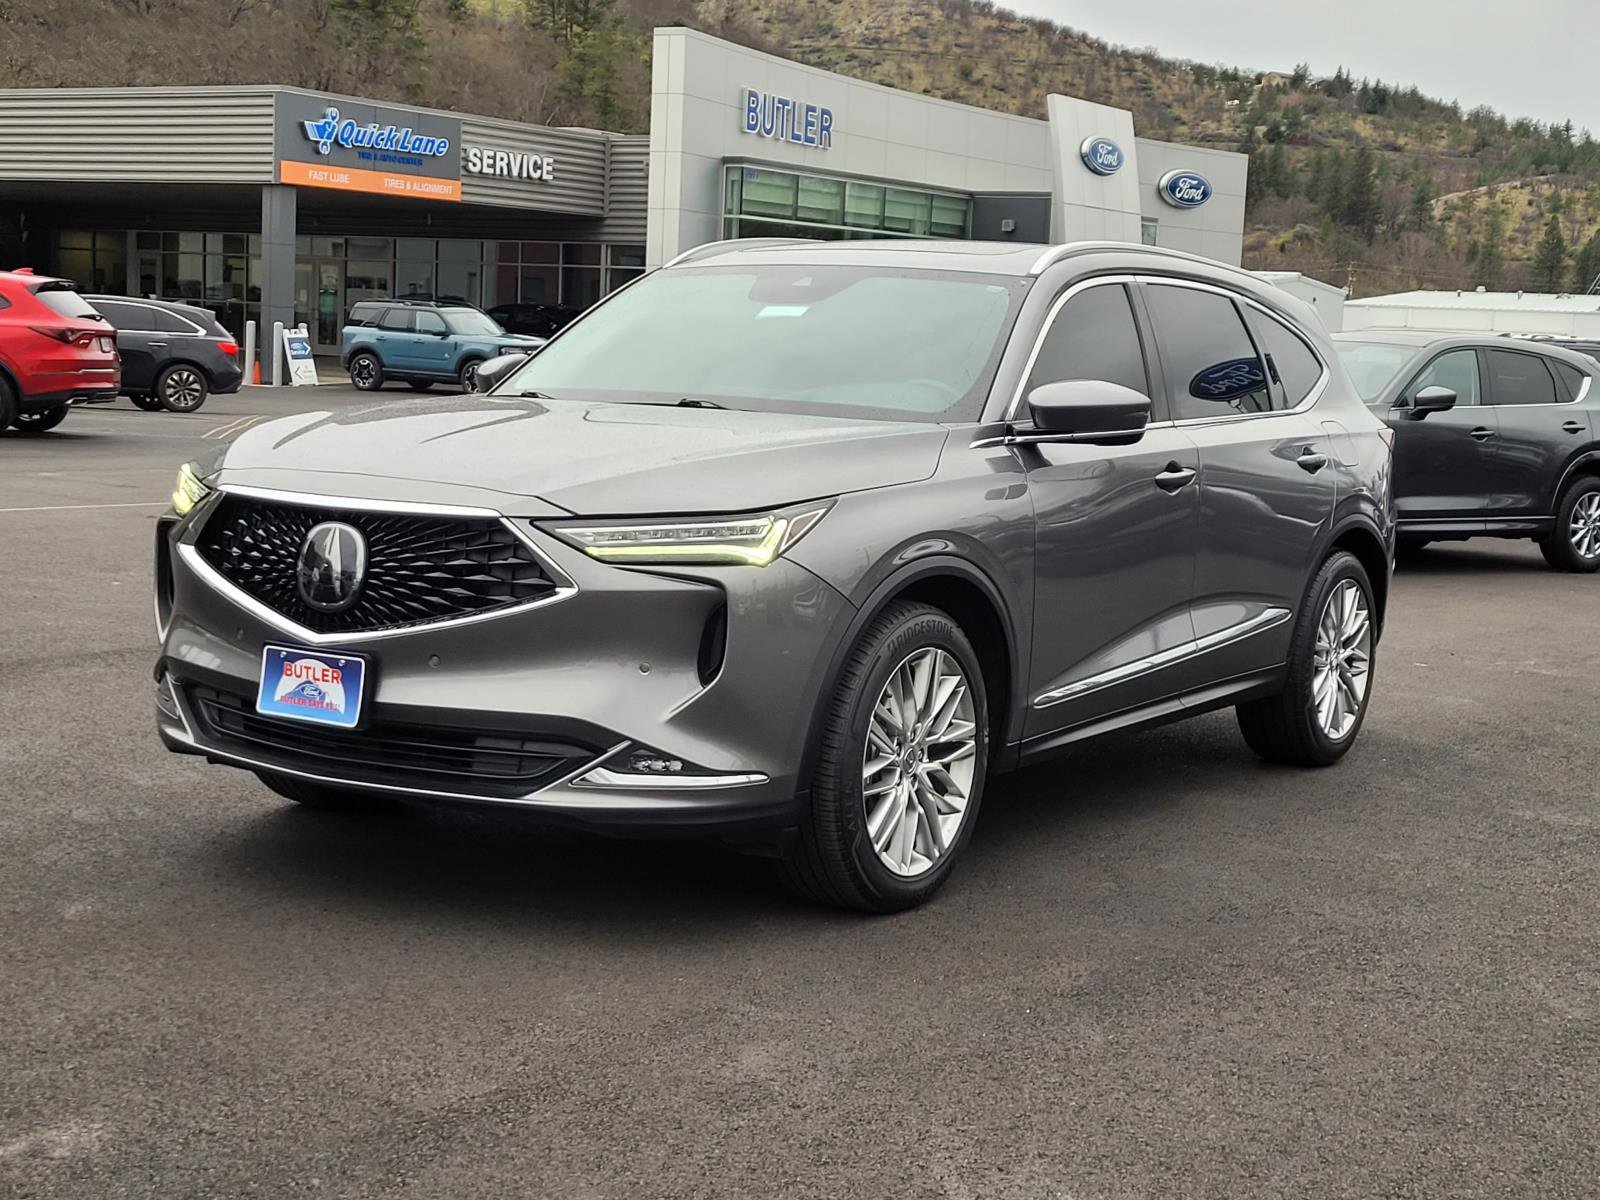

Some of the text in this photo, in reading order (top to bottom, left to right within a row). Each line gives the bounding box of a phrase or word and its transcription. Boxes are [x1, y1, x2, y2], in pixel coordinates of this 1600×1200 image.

[742, 87, 833, 149] BUTLER
[468, 147, 554, 180] SERVICE
[1097, 143, 1119, 166] Ford
[308, 170, 328, 180] FAST
[329, 172, 350, 184] LUBE
[384, 178, 405, 189] TIRES
[413, 181, 454, 194] ALIGNMENT
[1175, 178, 1205, 201] Ford
[283, 661, 343, 684] BUTLER
